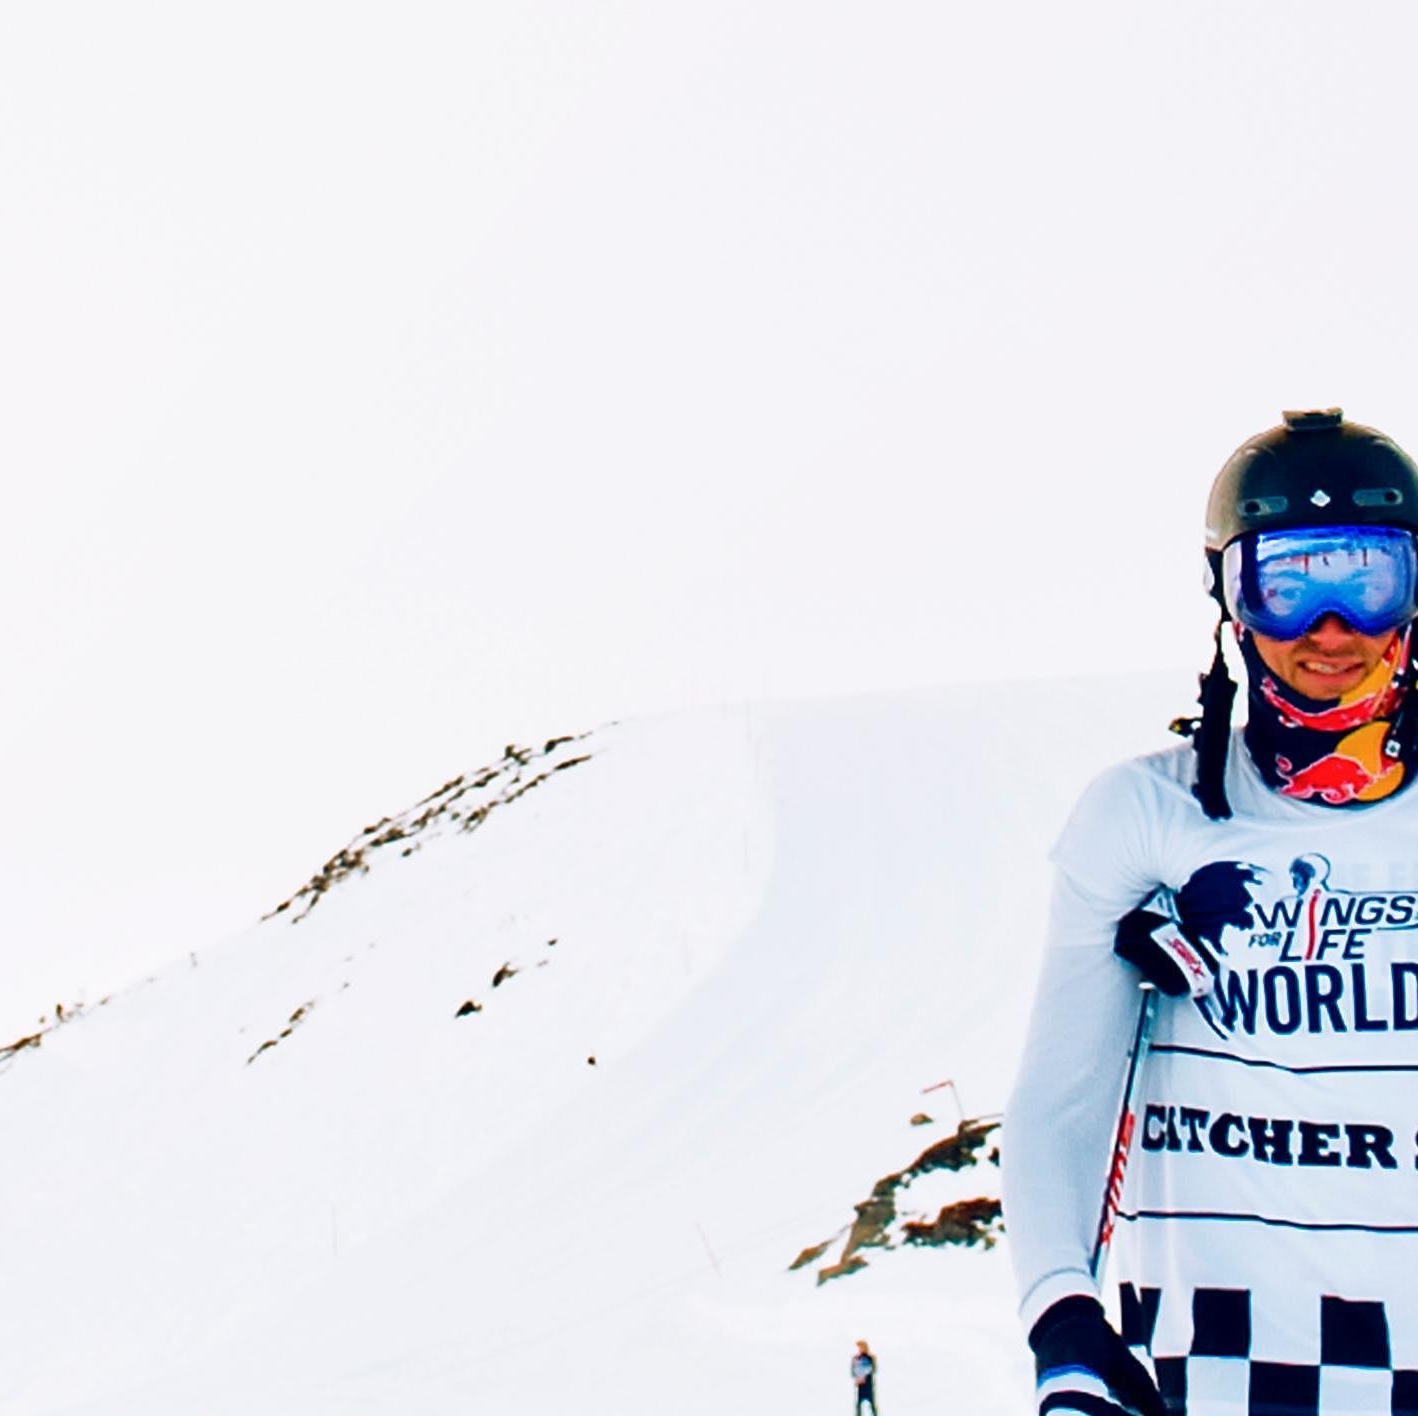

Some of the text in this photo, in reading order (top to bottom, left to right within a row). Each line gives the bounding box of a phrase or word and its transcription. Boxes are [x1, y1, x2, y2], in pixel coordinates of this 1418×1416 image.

[1254, 888, 1416, 929] WINGS
[1248, 927, 1372, 962] FOR LIFE
